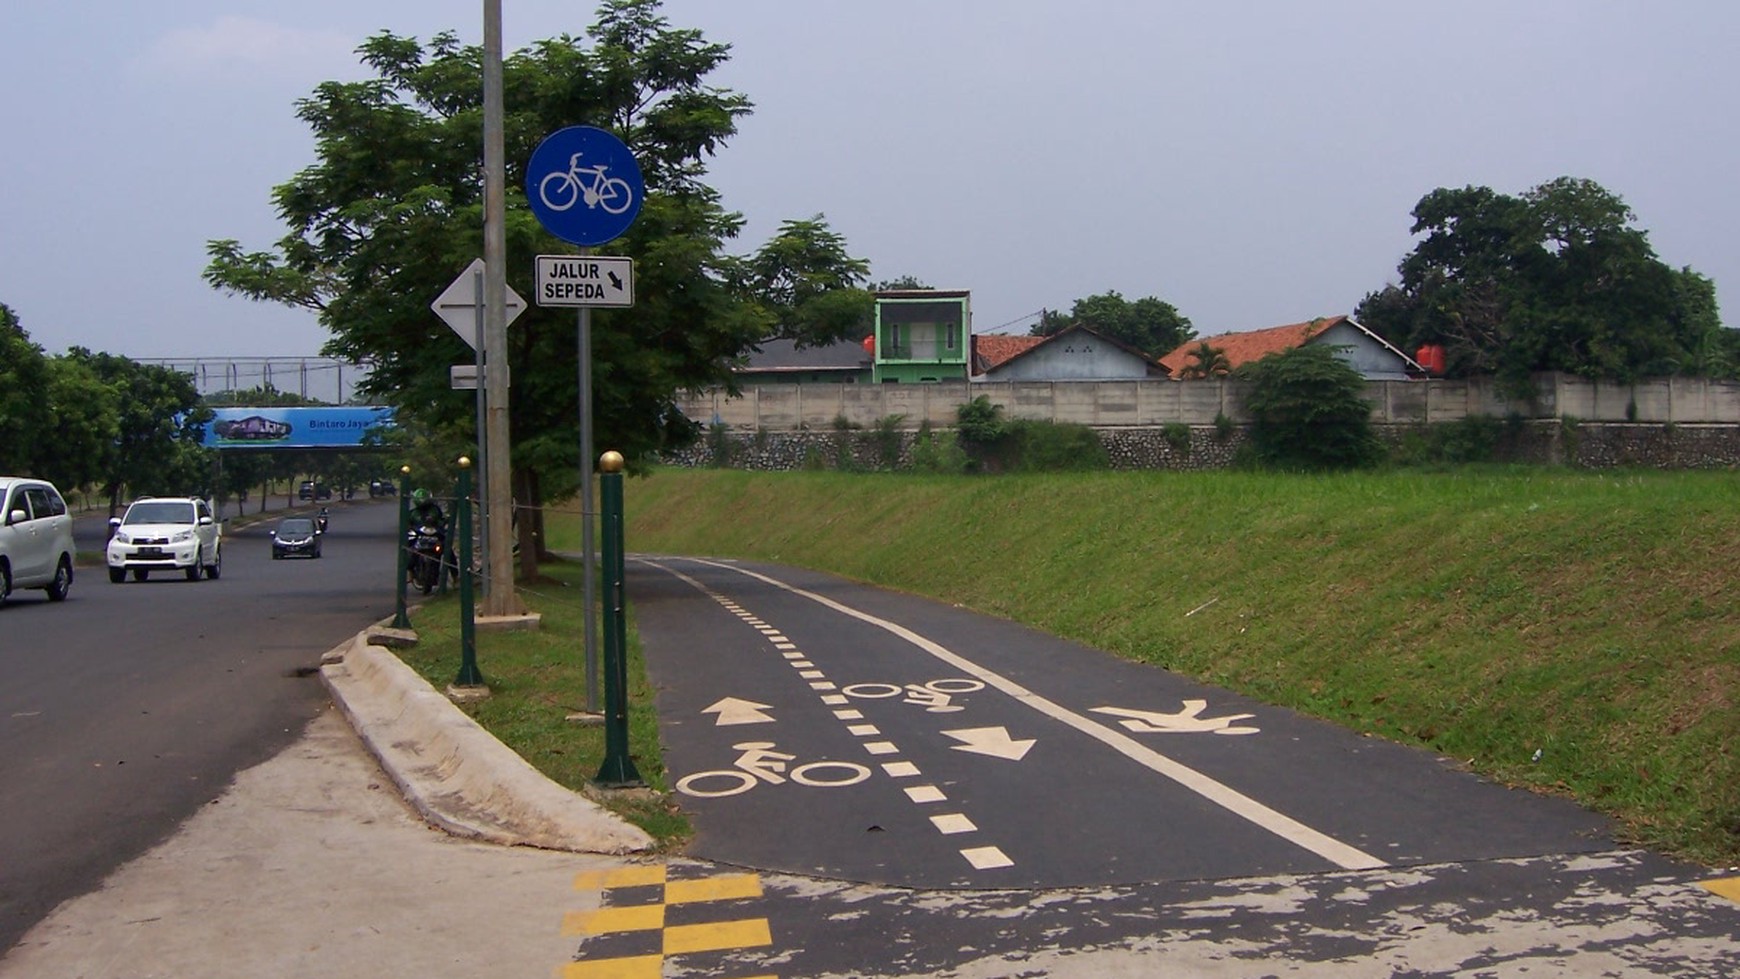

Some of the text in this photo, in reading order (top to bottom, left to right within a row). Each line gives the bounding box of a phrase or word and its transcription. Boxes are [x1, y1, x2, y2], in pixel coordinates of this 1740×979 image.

[549, 263, 600, 279] JALUR
[545, 283, 605, 299] SEPEDA
[309, 420, 346, 429] Bintaro
